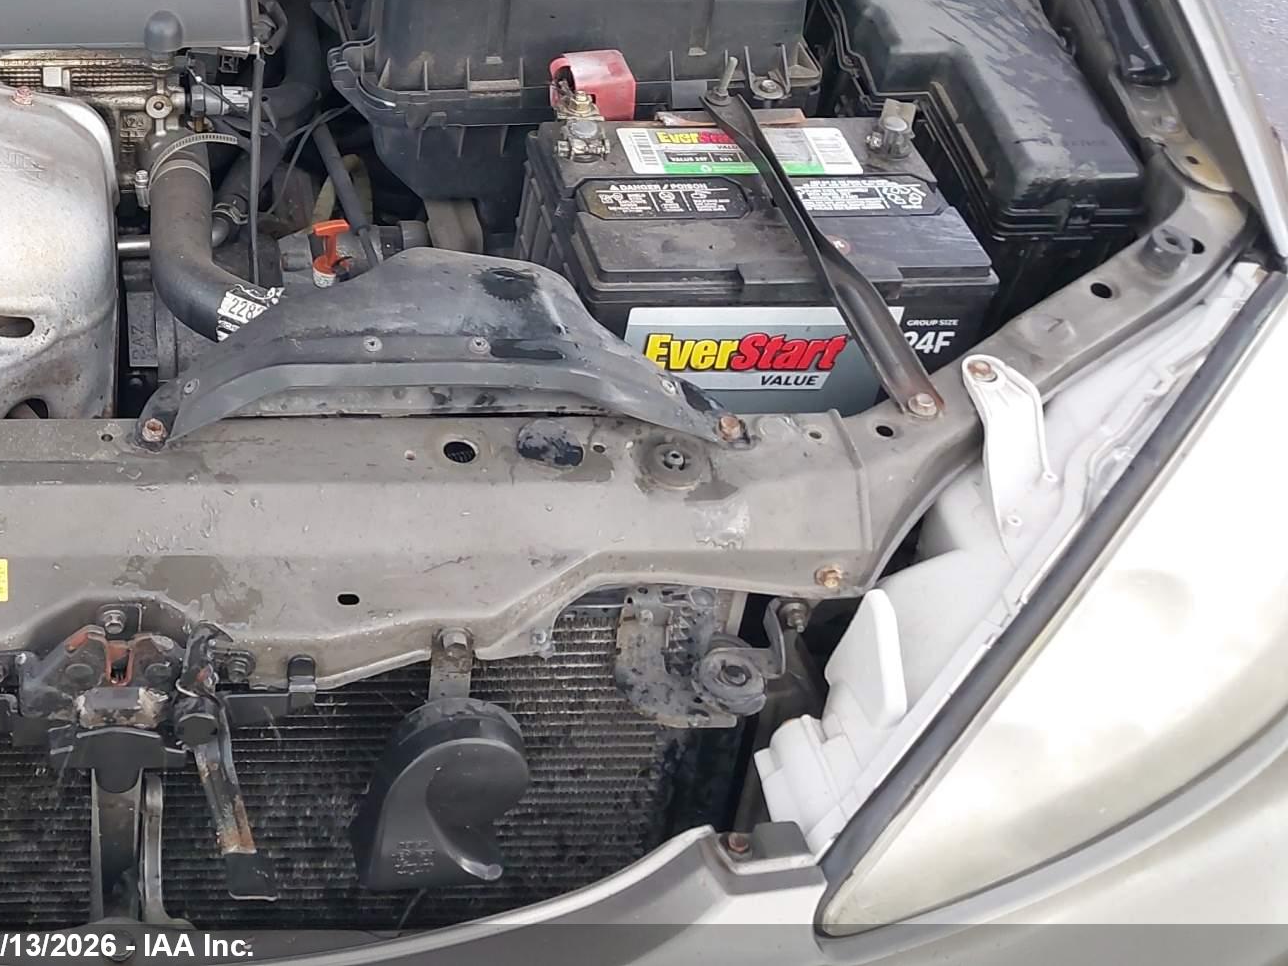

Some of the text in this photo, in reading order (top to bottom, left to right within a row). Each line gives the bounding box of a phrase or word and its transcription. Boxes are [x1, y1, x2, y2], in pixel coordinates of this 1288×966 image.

[906, 319, 938, 327] GROUP
[644, 332, 850, 371] EverStart
[760, 374, 820, 387] VALUE
